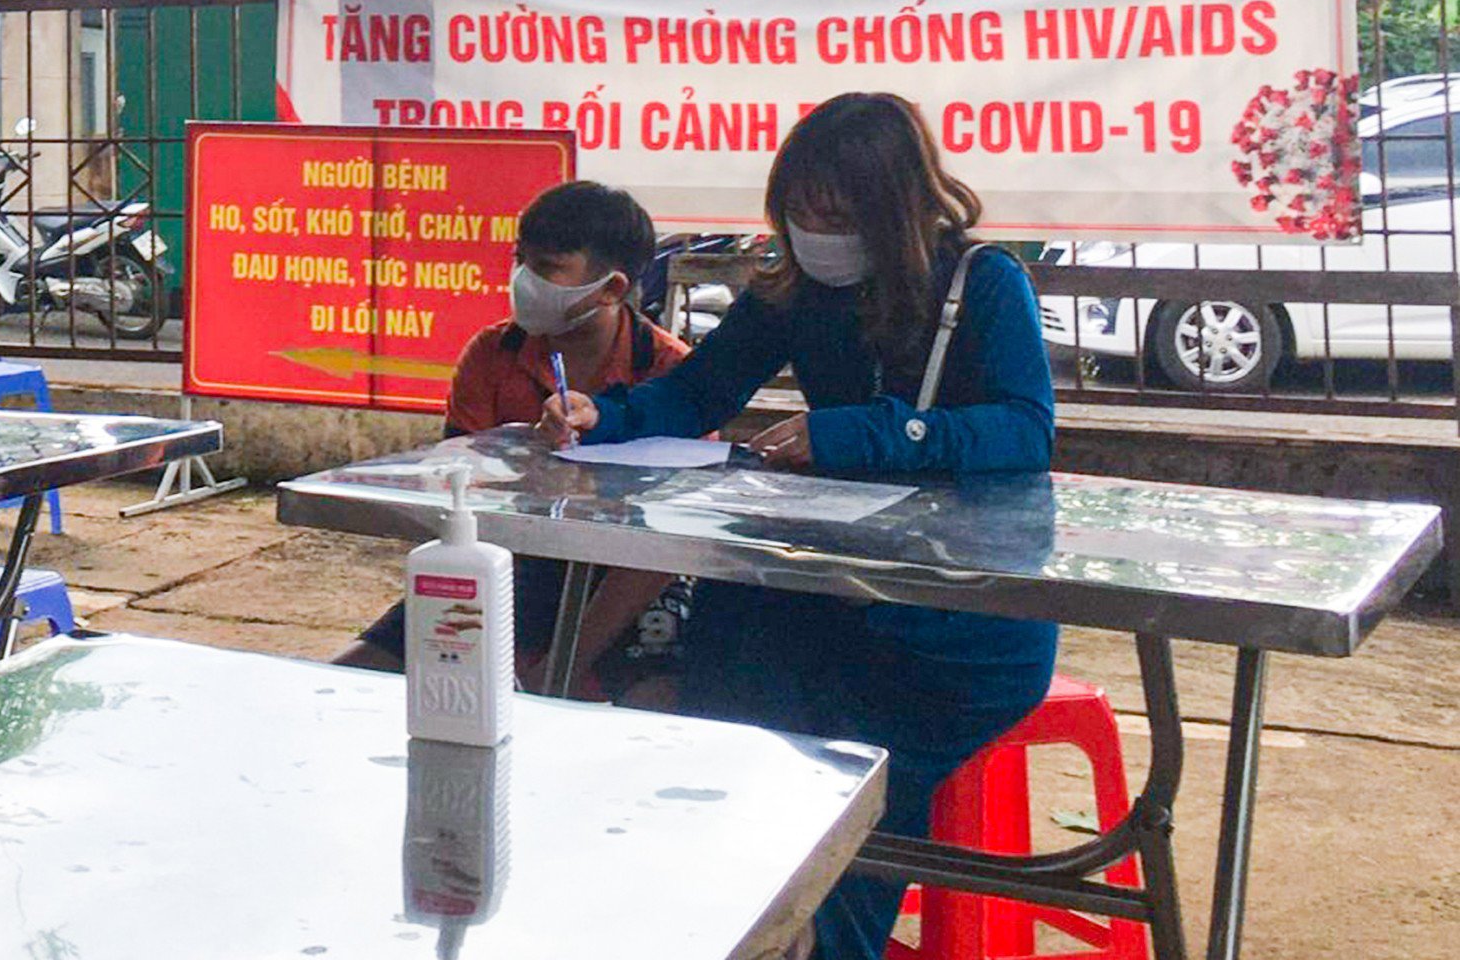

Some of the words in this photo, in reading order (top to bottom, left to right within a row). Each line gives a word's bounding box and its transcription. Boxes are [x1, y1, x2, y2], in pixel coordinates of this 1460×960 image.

[322, 3, 431, 62] TĂNG
[448, 3, 607, 63] CƯỜNG
[624, 9, 797, 65] PHÒNG
[1025, 0, 1278, 61] HIV/AIDS
[542, 84, 621, 150] BỐI
[642, 85, 777, 152] CẢNH
[941, 101, 1201, 154] COVID-19
[303, 156, 373, 188] NGƯỜI
[383, 159, 447, 195] BỆNH
[210, 204, 246, 235] HO,
[253, 198, 300, 236] SỐT,
[306, 204, 352, 237] KHÓ
[360, 203, 411, 241] THỞ,
[419, 205, 483, 242] CHẢY
[232, 252, 278, 280] ĐAU
[285, 256, 355, 288] HỌNG,
[362, 253, 408, 288] TỨC
[414, 262, 489, 297] NGỰC,
[311, 304, 334, 332] ĐI
[341, 298, 377, 334] LỐI
[385, 305, 434, 338] NÀY
